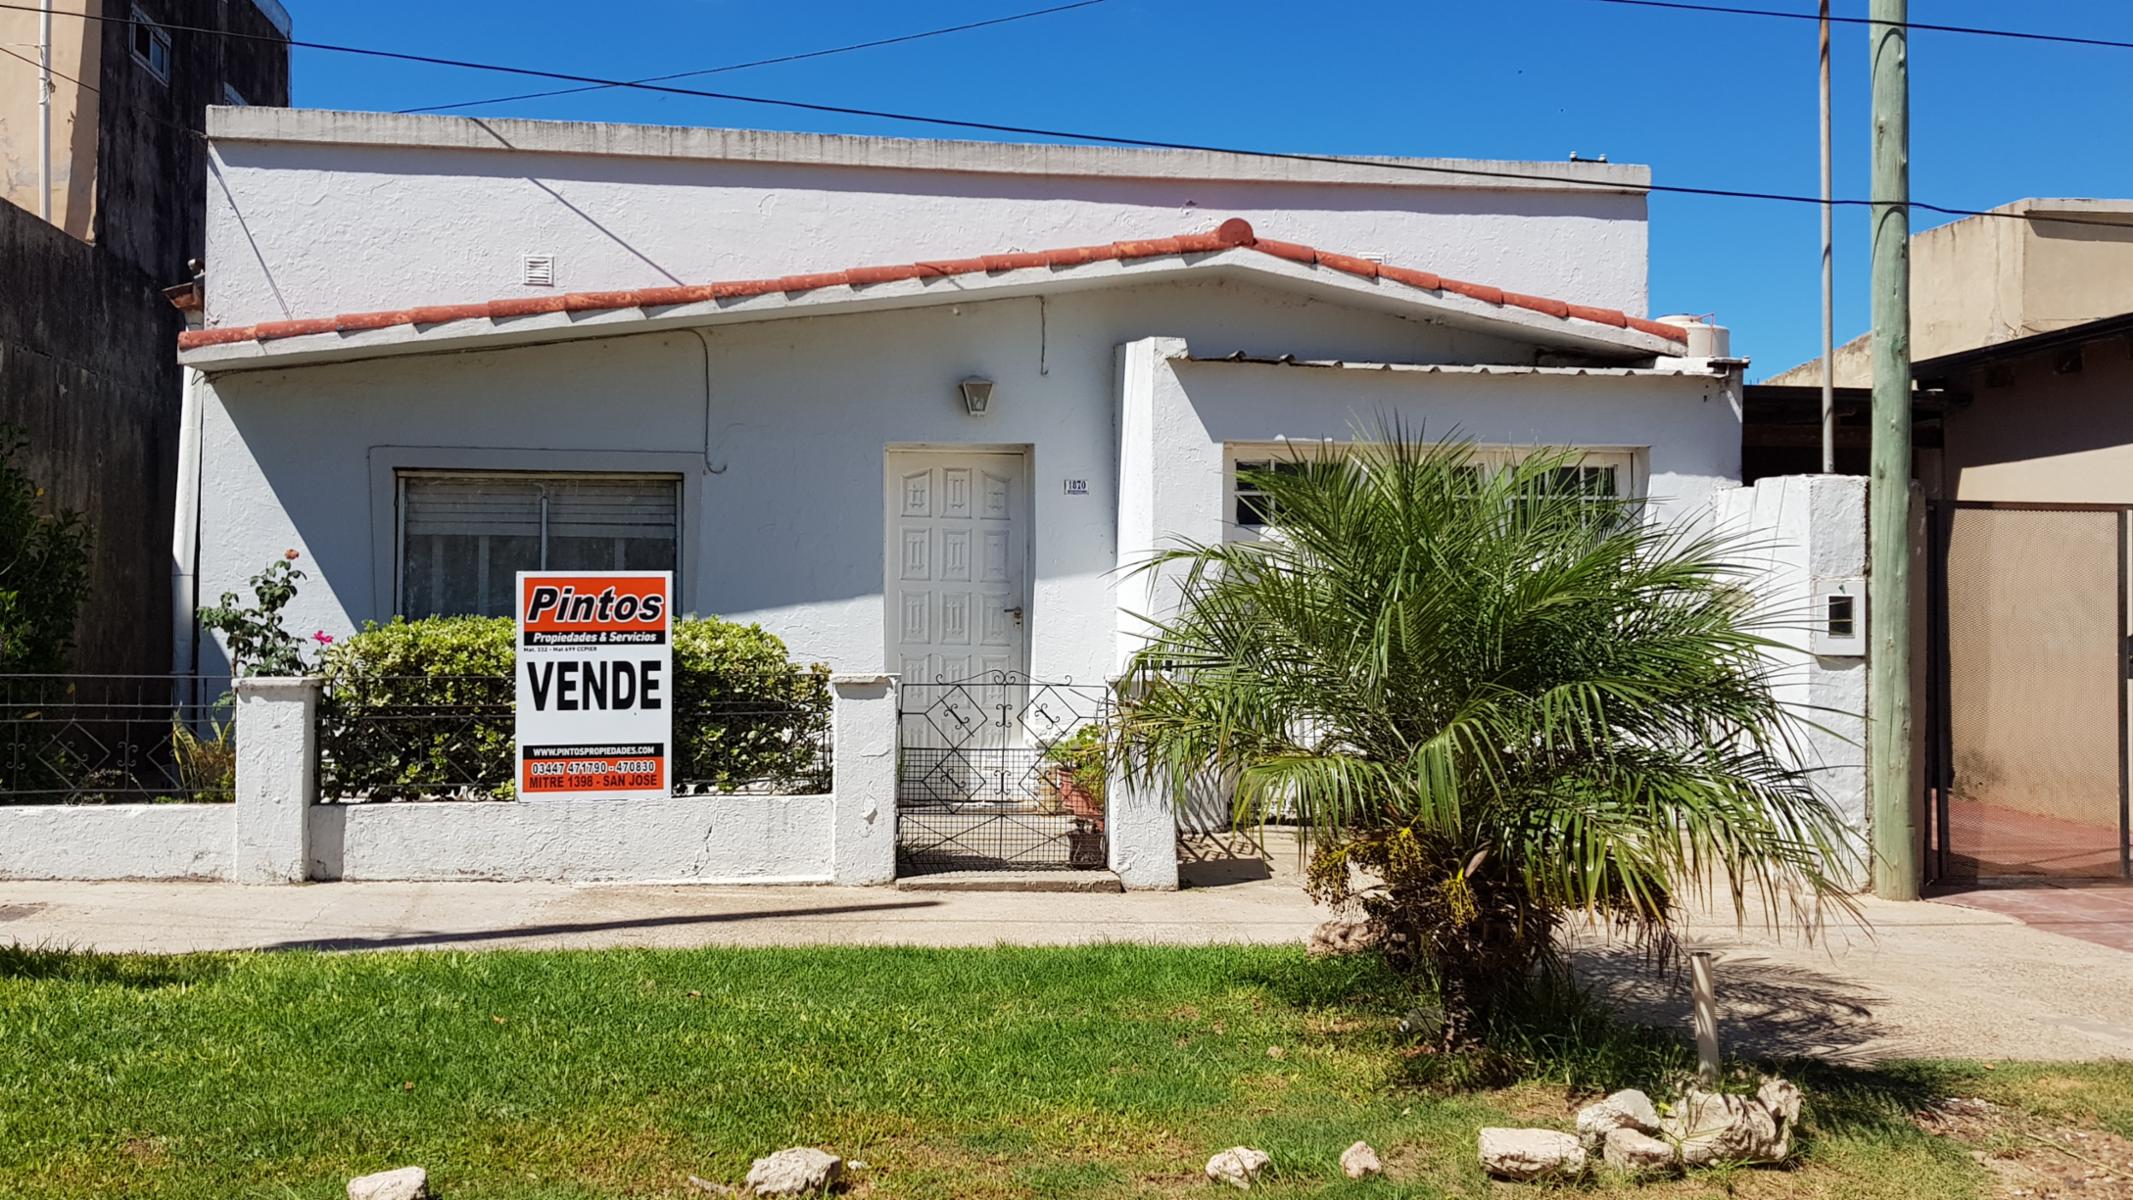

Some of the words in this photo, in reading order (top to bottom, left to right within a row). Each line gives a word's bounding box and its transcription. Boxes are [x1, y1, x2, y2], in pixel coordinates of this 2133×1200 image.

[1069, 480, 1086, 490] 1870
[526, 586, 664, 623] Pintos
[533, 633, 597, 644] Propiedades
[599, 632, 607, 642] &
[609, 632, 657, 642] Servicios
[527, 661, 662, 711] VENDE
[533, 747, 655, 756] WWW.PINTOSPROPIEDADES.COM
[532, 762, 565, 775] 03447
[567, 761, 607, 774] 471790
[616, 760, 656, 773] 470830
[529, 777, 564, 788] MITRE
[568, 776, 593, 787] 1398
[603, 775, 625, 786] SAN
[629, 774, 657, 786] JOSE
